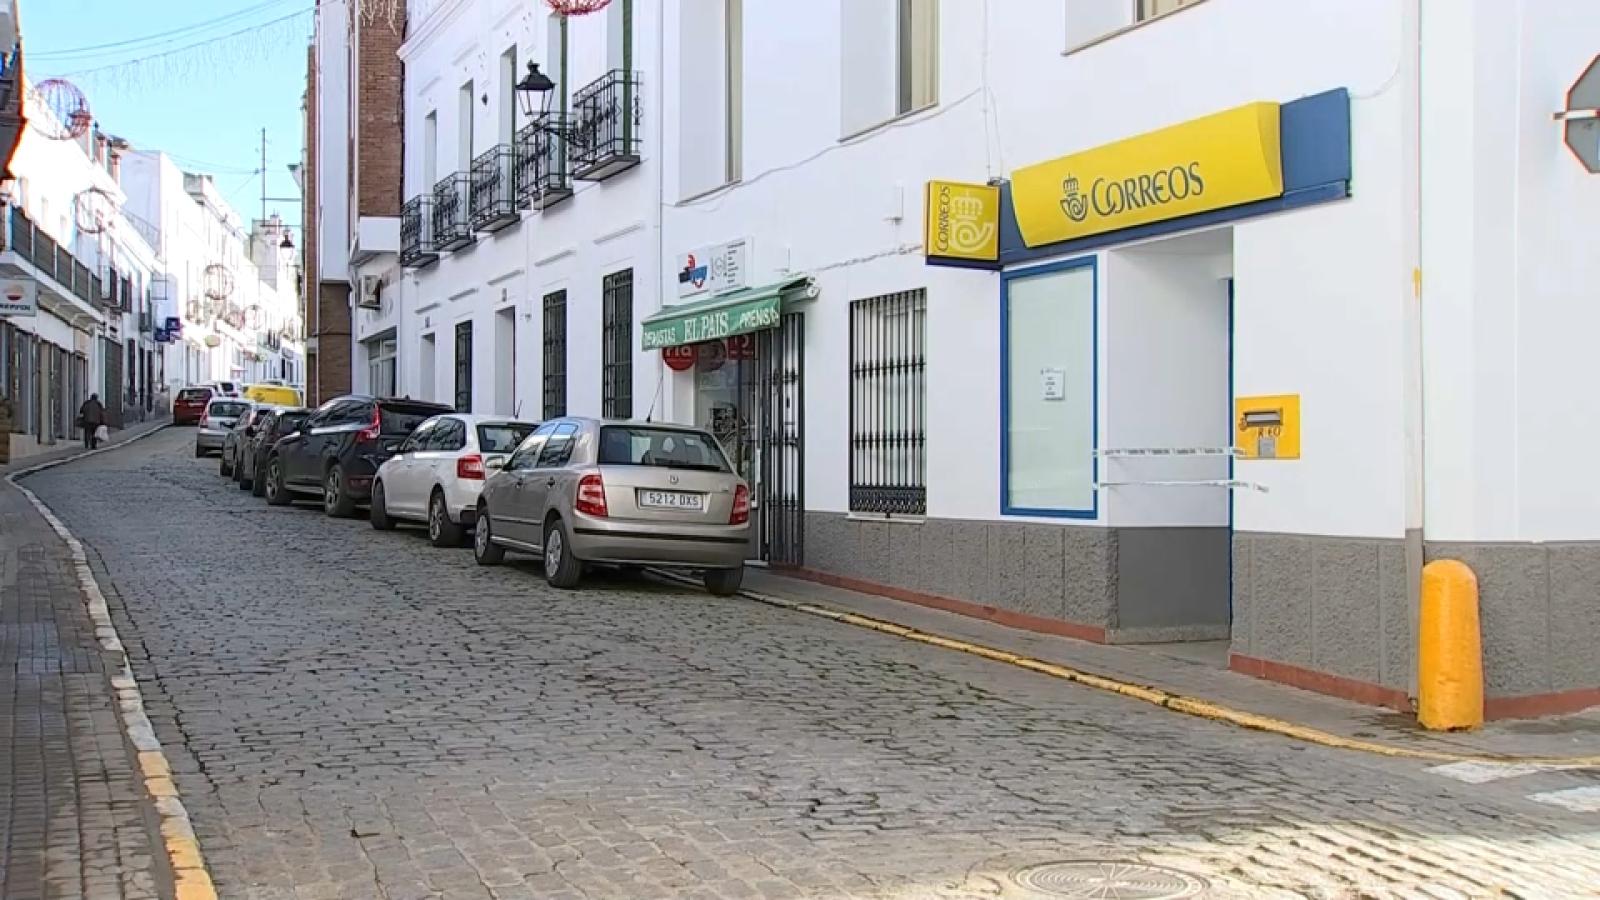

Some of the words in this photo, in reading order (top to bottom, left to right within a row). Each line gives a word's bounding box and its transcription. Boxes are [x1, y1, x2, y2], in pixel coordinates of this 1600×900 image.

[1091, 161, 1204, 216] CORREOS
[935, 185, 950, 252] CORREOS
[684, 317, 698, 342] EL
[649, 492, 676, 506] 5212
